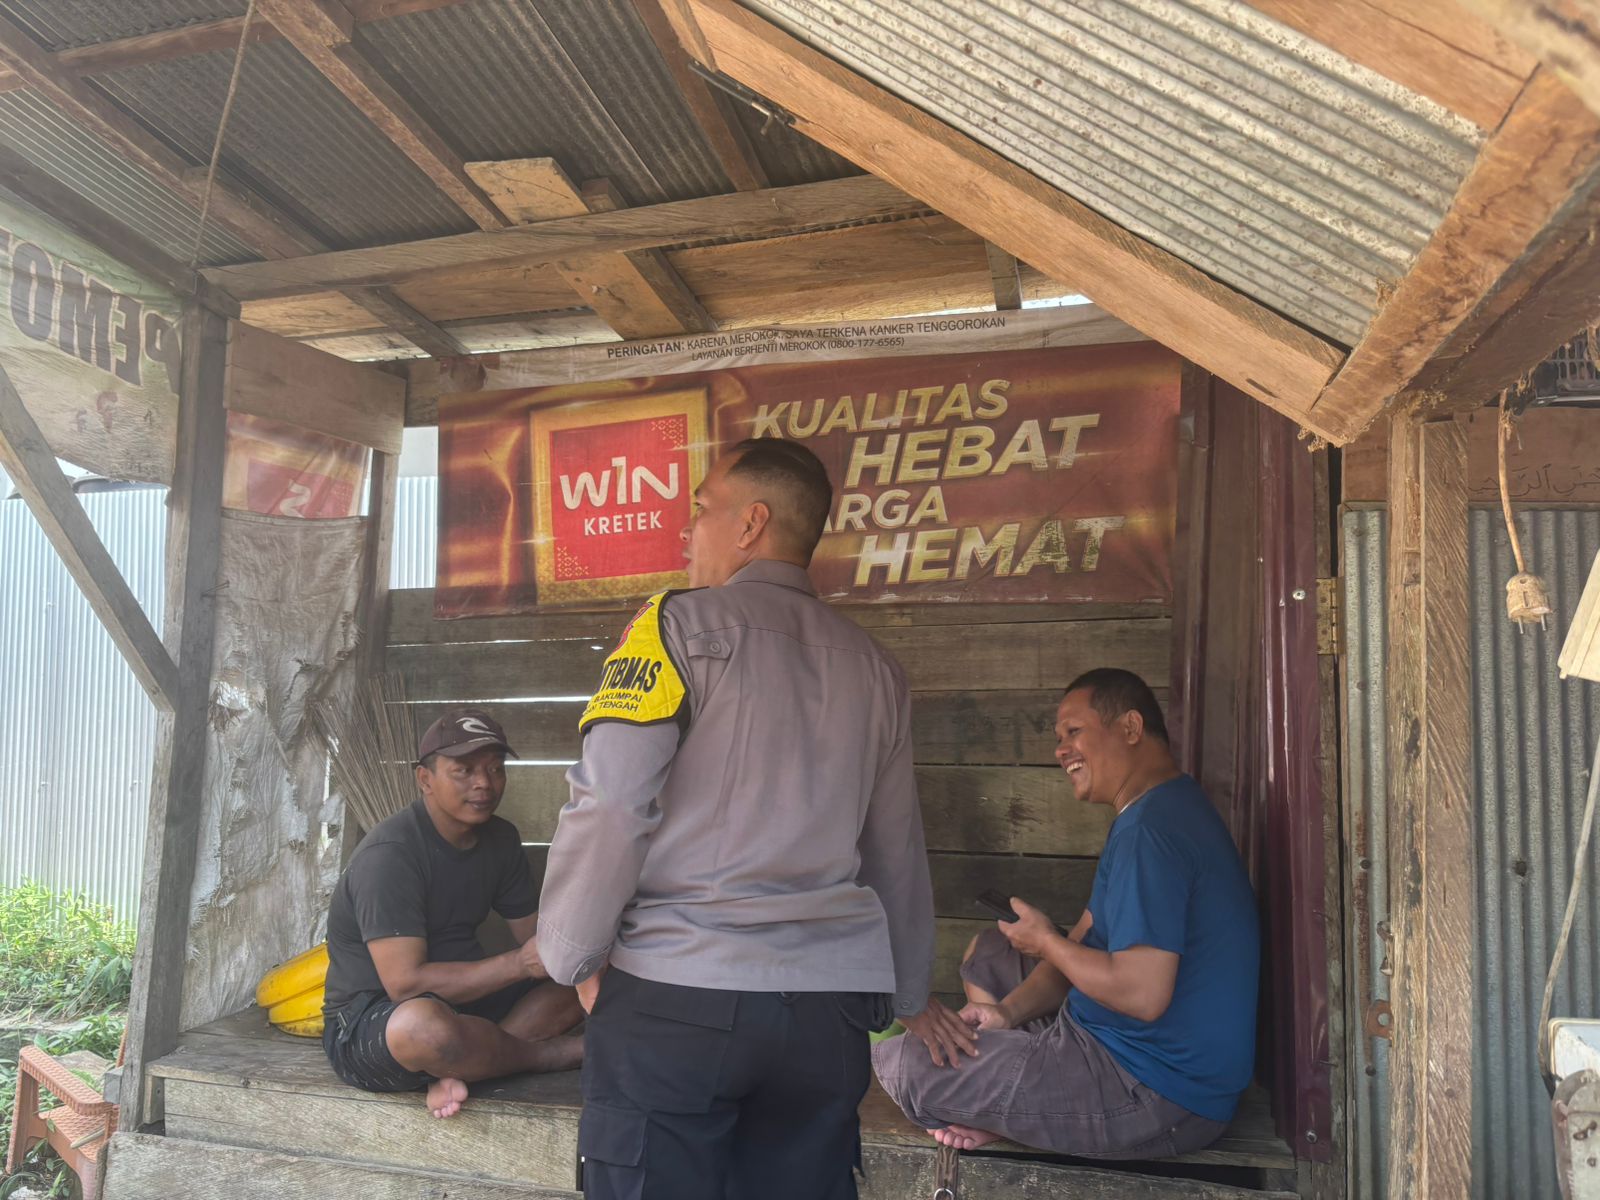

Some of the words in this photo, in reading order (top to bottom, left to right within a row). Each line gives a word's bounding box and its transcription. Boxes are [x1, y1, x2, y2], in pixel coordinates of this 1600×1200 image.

[607, 341, 684, 359] PERINGATAN:
[687, 336, 727, 350] KARENA
[786, 328, 815, 340] SAYA
[817, 324, 867, 339] TERKENA
[869, 323, 914, 336] KANKER
[917, 316, 1006, 333] TENGGOROKAN
[692, 349, 733, 361] LAYANAN
[734, 343, 777, 357] BERHENTI
[780, 340, 827, 352] MEROKOK
[828, 337, 904, 349] (0800-177-6565)
[752, 379, 1011, 439] KUALITAS
[844, 413, 1101, 488] HEBAT
[584, 511, 663, 536] KRETEK
[823, 486, 948, 534] RGA
[853, 515, 1125, 587] HEMAT
[600, 657, 663, 693] TIBMAS
[600, 702, 639, 712] TENGAH
